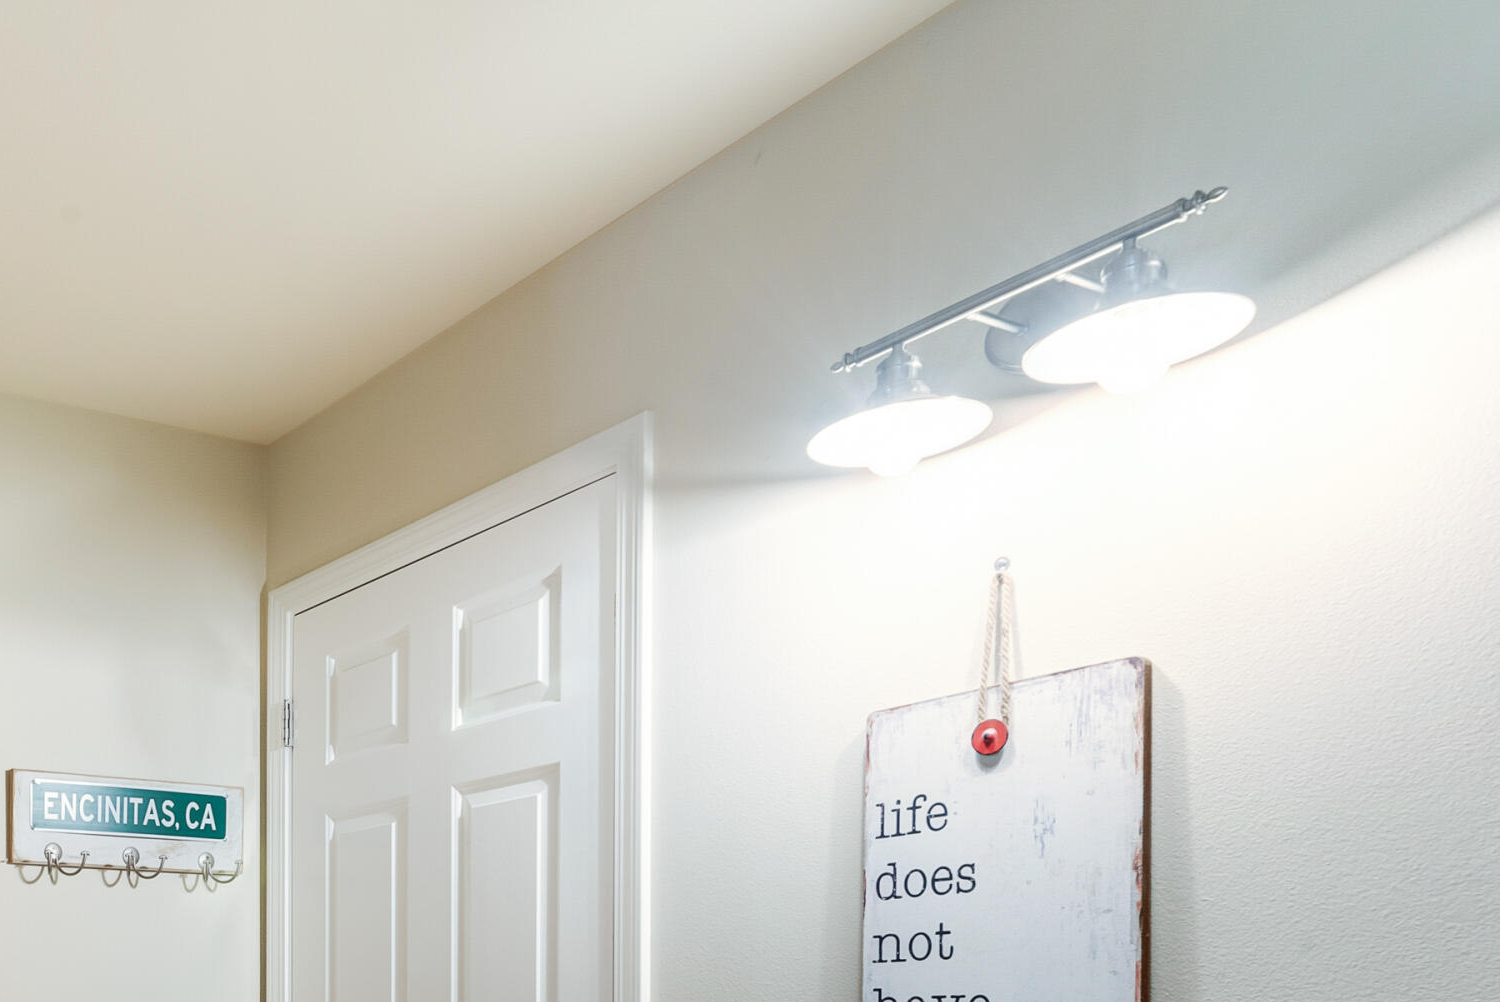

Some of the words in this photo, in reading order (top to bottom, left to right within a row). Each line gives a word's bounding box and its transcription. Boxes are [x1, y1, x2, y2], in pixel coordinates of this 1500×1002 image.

[43, 791, 180, 830] ENCINITAS,
[185, 801, 217, 831] CA
[874, 795, 949, 839] life
[874, 862, 977, 901] does
[872, 922, 954, 963] not
